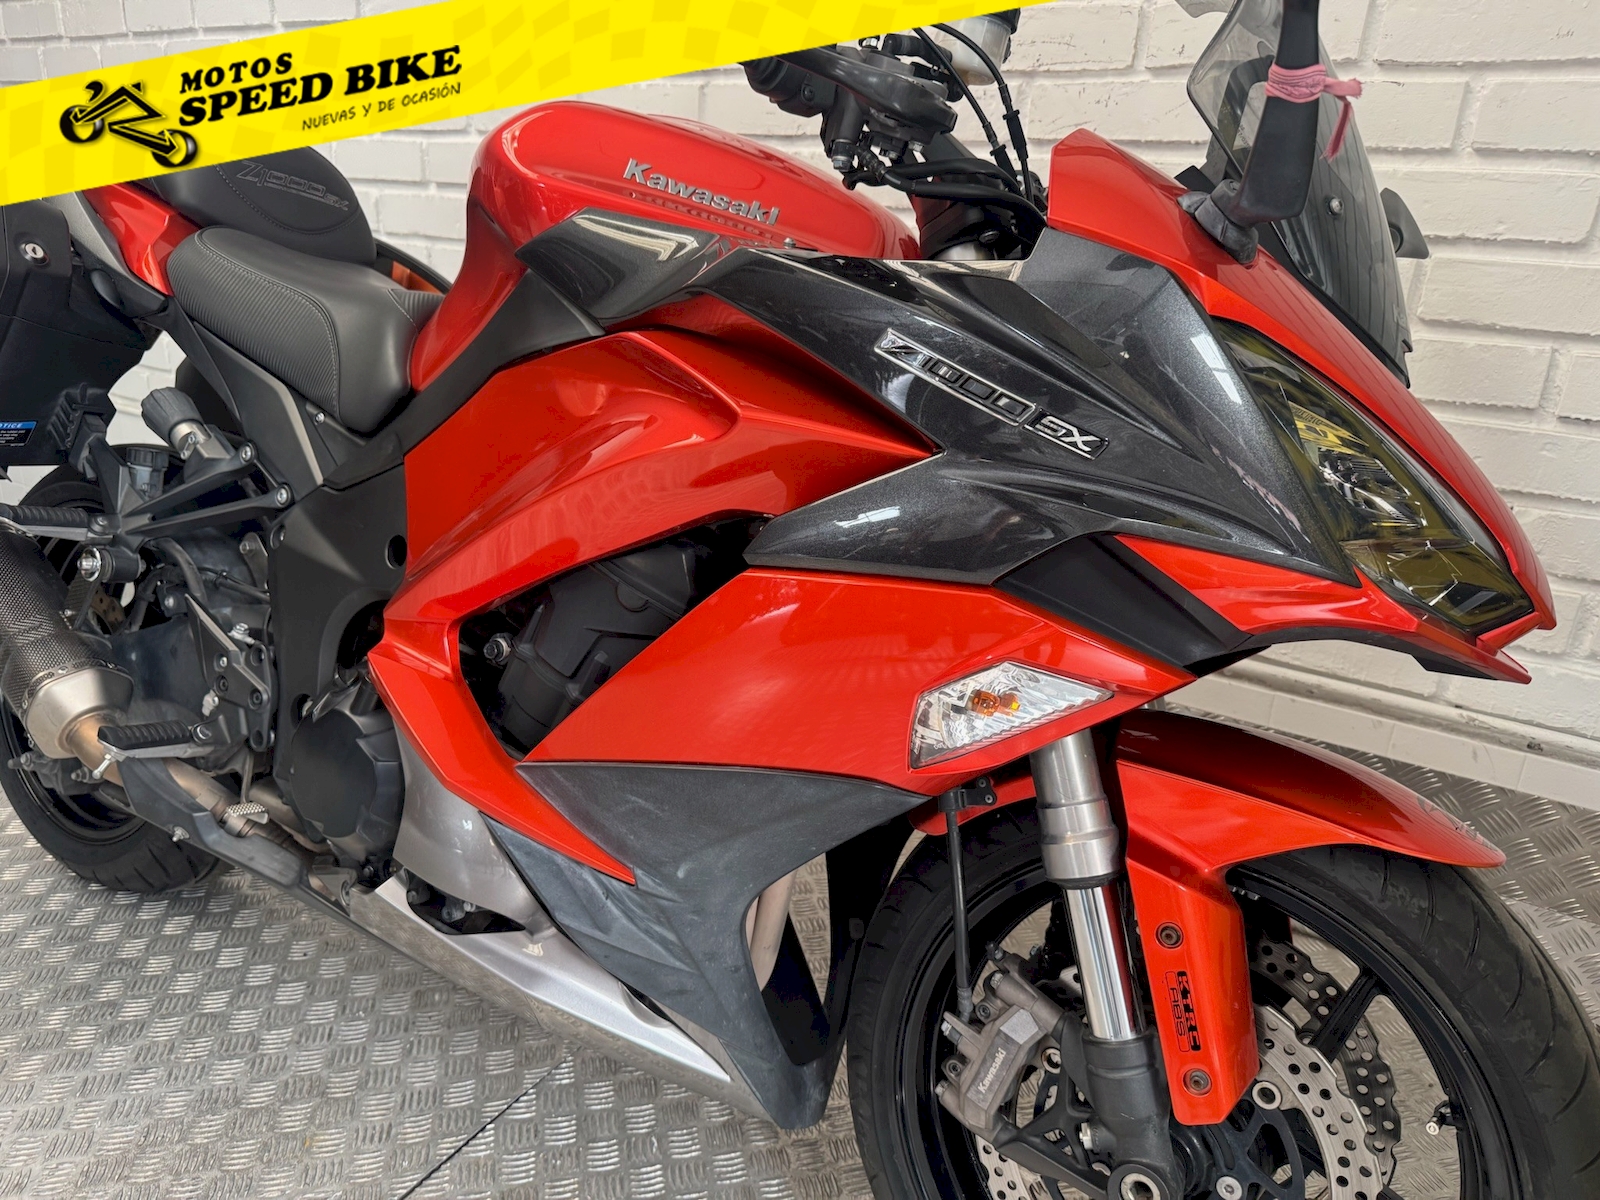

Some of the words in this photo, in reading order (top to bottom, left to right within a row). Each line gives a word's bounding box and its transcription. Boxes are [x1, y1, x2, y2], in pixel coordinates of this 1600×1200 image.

[623, 158, 780, 225] Kawasaki
[1169, 987, 1186, 1037] ABS
[977, 1047, 1007, 1094] Kawasaki
